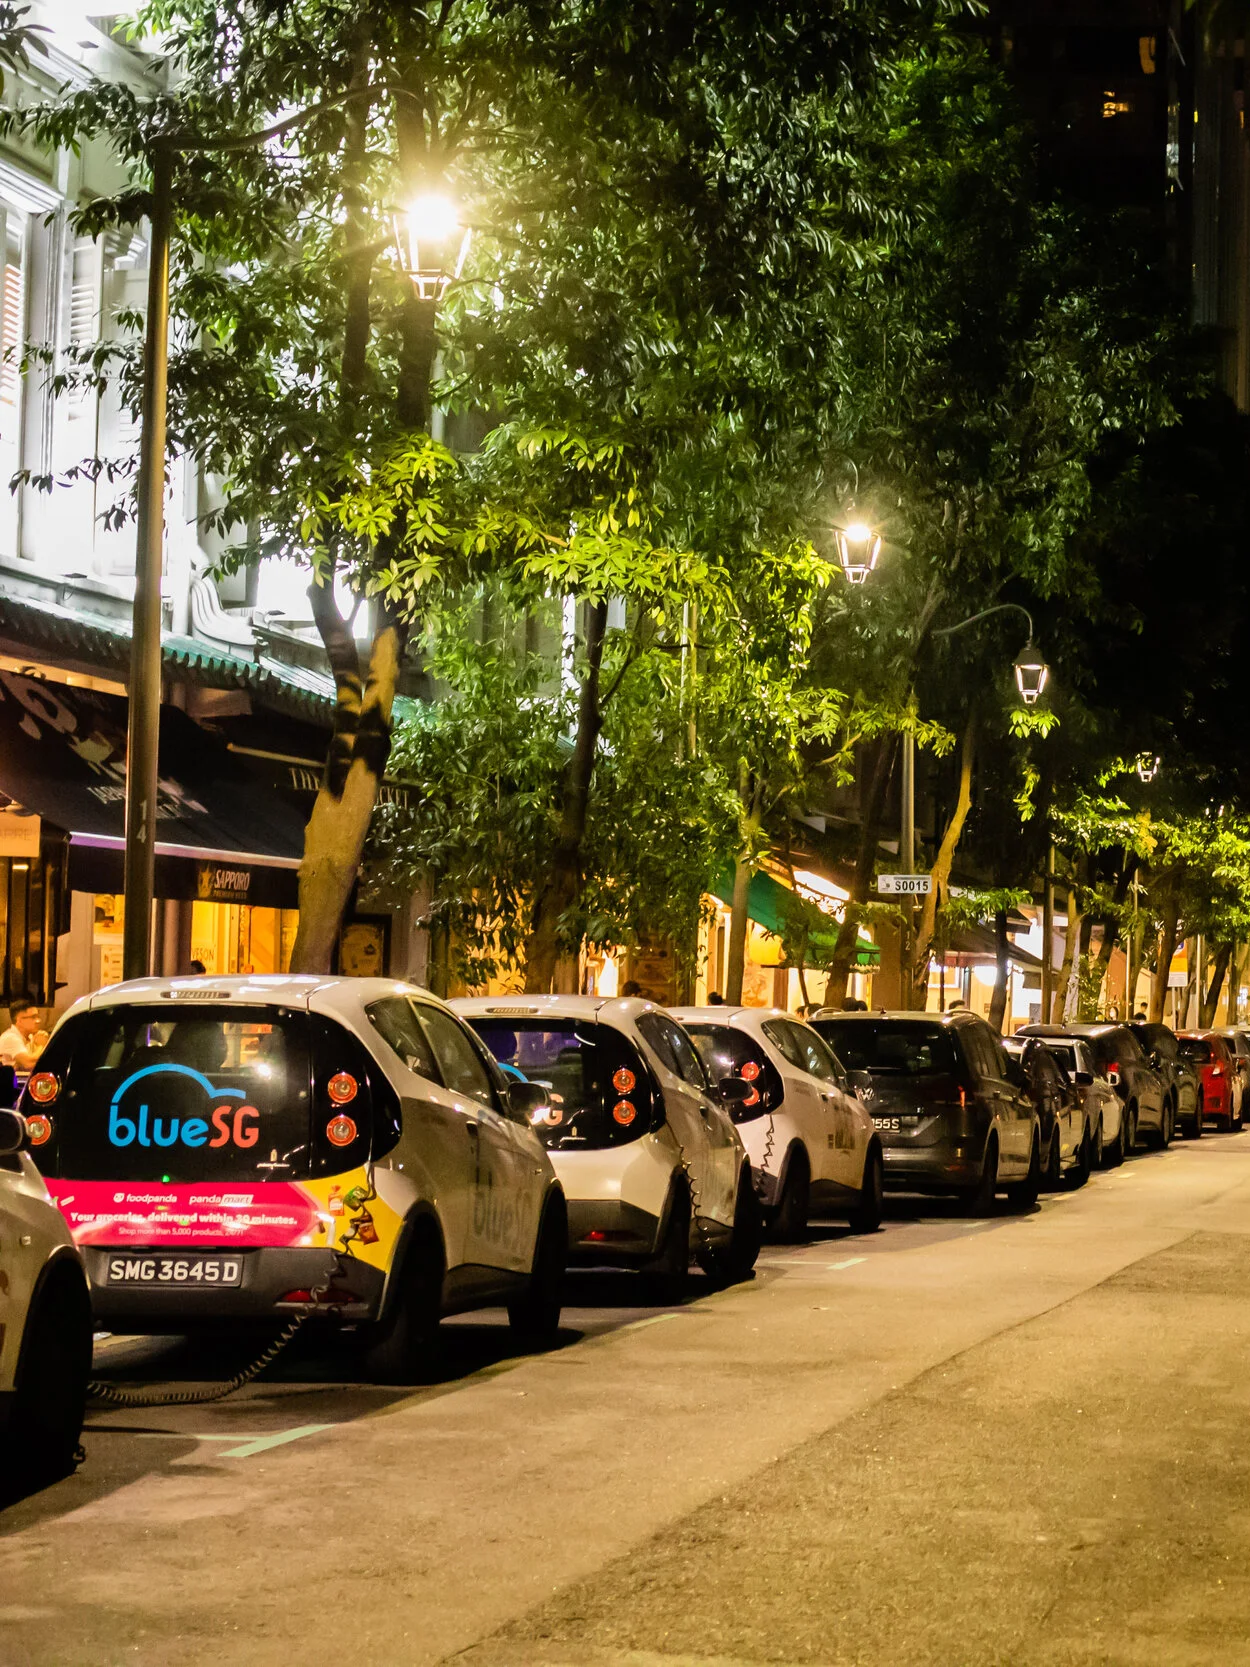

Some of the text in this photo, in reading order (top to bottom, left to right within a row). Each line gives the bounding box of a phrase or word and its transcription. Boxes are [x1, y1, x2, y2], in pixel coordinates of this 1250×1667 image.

[214, 869, 251, 891] SAPPORO
[895, 880, 929, 891] S0015
[108, 1104, 260, 1148] blueSG
[125, 1193, 177, 1204] foodpanda
[70, 1212, 95, 1222] Your
[148, 1213, 198, 1223] delivered
[199, 1213, 233, 1223] within
[250, 1214, 298, 1225] minutes.
[118, 1227, 136, 1237] Shop
[172, 1227, 192, 1236] 5,000
